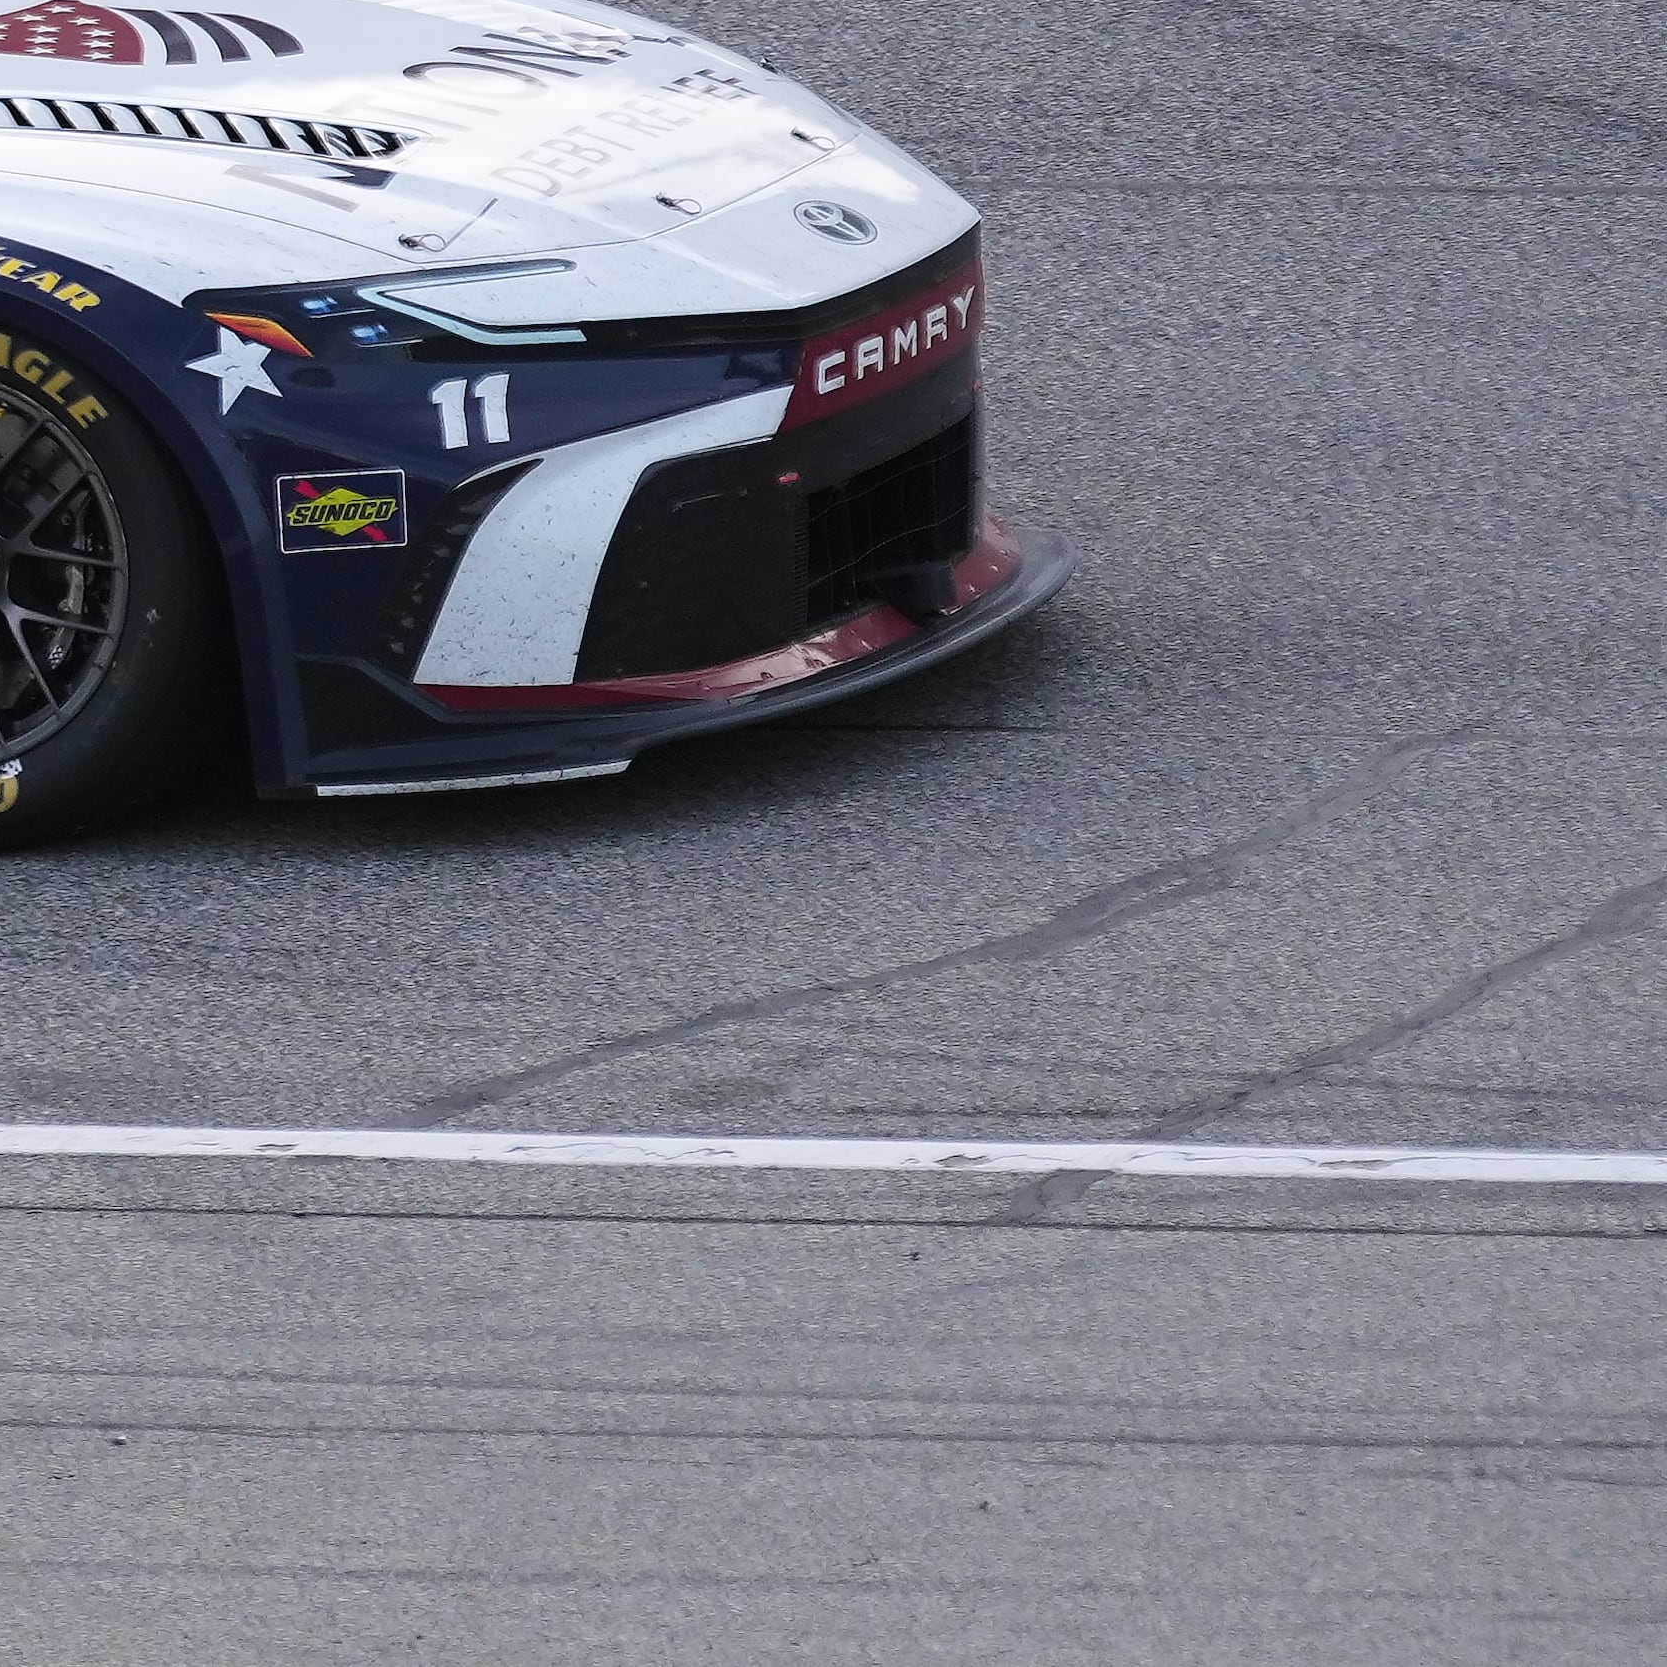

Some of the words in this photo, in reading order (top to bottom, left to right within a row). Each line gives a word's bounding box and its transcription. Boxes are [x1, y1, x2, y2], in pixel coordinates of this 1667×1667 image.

[815, 282, 979, 396] CAMRY
[430, 372, 512, 450] 11
[291, 499, 396, 526] SUNOCO
